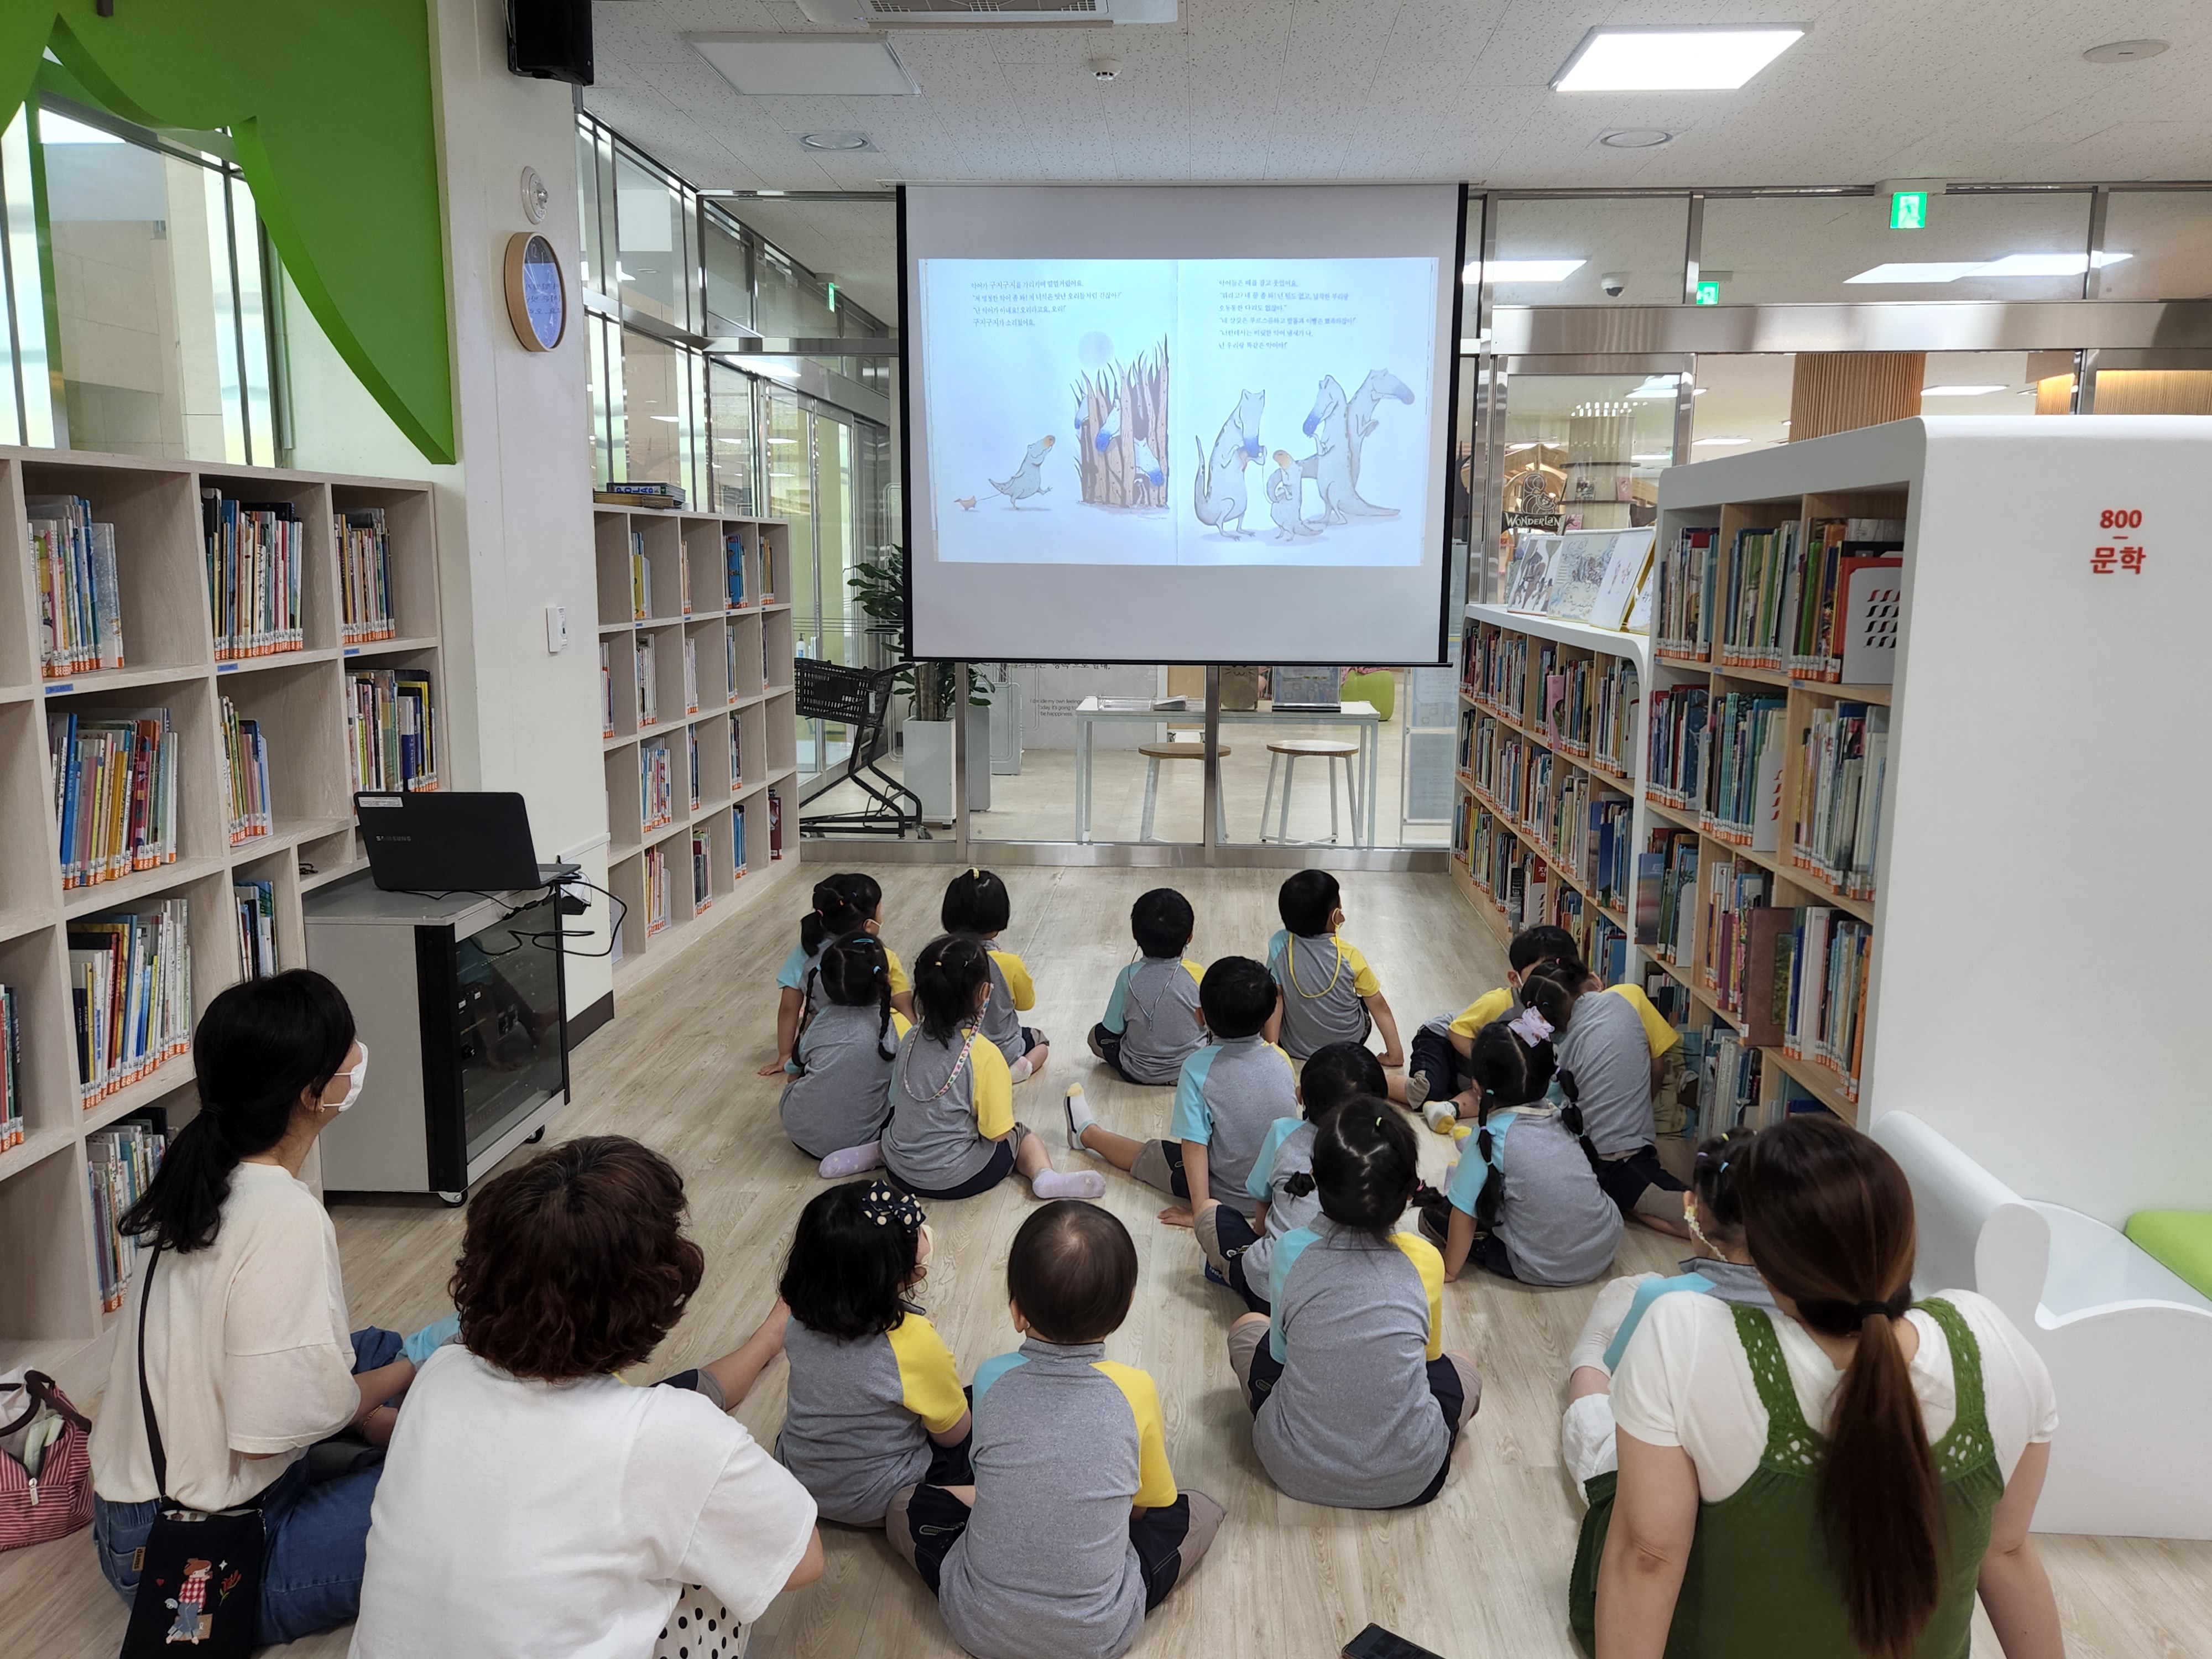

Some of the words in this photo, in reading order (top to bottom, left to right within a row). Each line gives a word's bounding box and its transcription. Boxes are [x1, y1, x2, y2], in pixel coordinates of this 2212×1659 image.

[973, 318, 1004, 327] 구지구지가
[2100, 510, 2142, 529] 800
[2090, 546, 2147, 574] 문학
